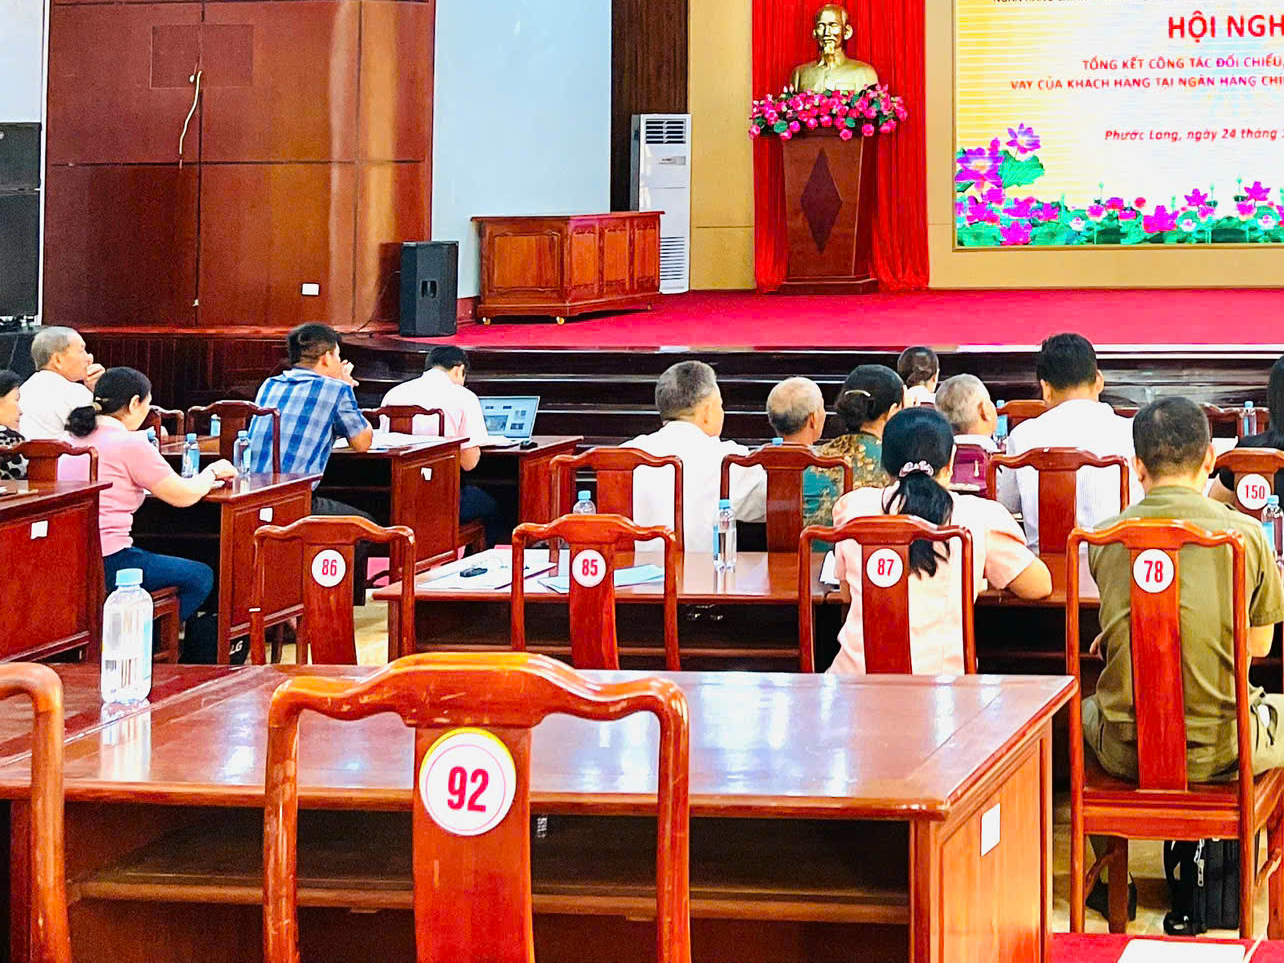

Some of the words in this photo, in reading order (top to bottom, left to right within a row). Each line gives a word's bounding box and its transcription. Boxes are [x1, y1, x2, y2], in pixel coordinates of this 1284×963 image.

[1168, 10, 1216, 43] HỘI
[1149, 55, 1185, 70] CÔNG
[1010, 80, 1033, 90] VAY
[1104, 129, 1144, 141] Phước
[1149, 129, 1182, 143] Long,
[1186, 130, 1217, 143] ngày
[1221, 128, 1237, 139] 24
[1244, 484, 1266, 500] 150
[321, 558, 338, 577] 86
[581, 558, 599, 577] 85
[877, 557, 895, 577] 87
[1143, 560, 1164, 583] 78
[447, 765, 489, 813] 92
